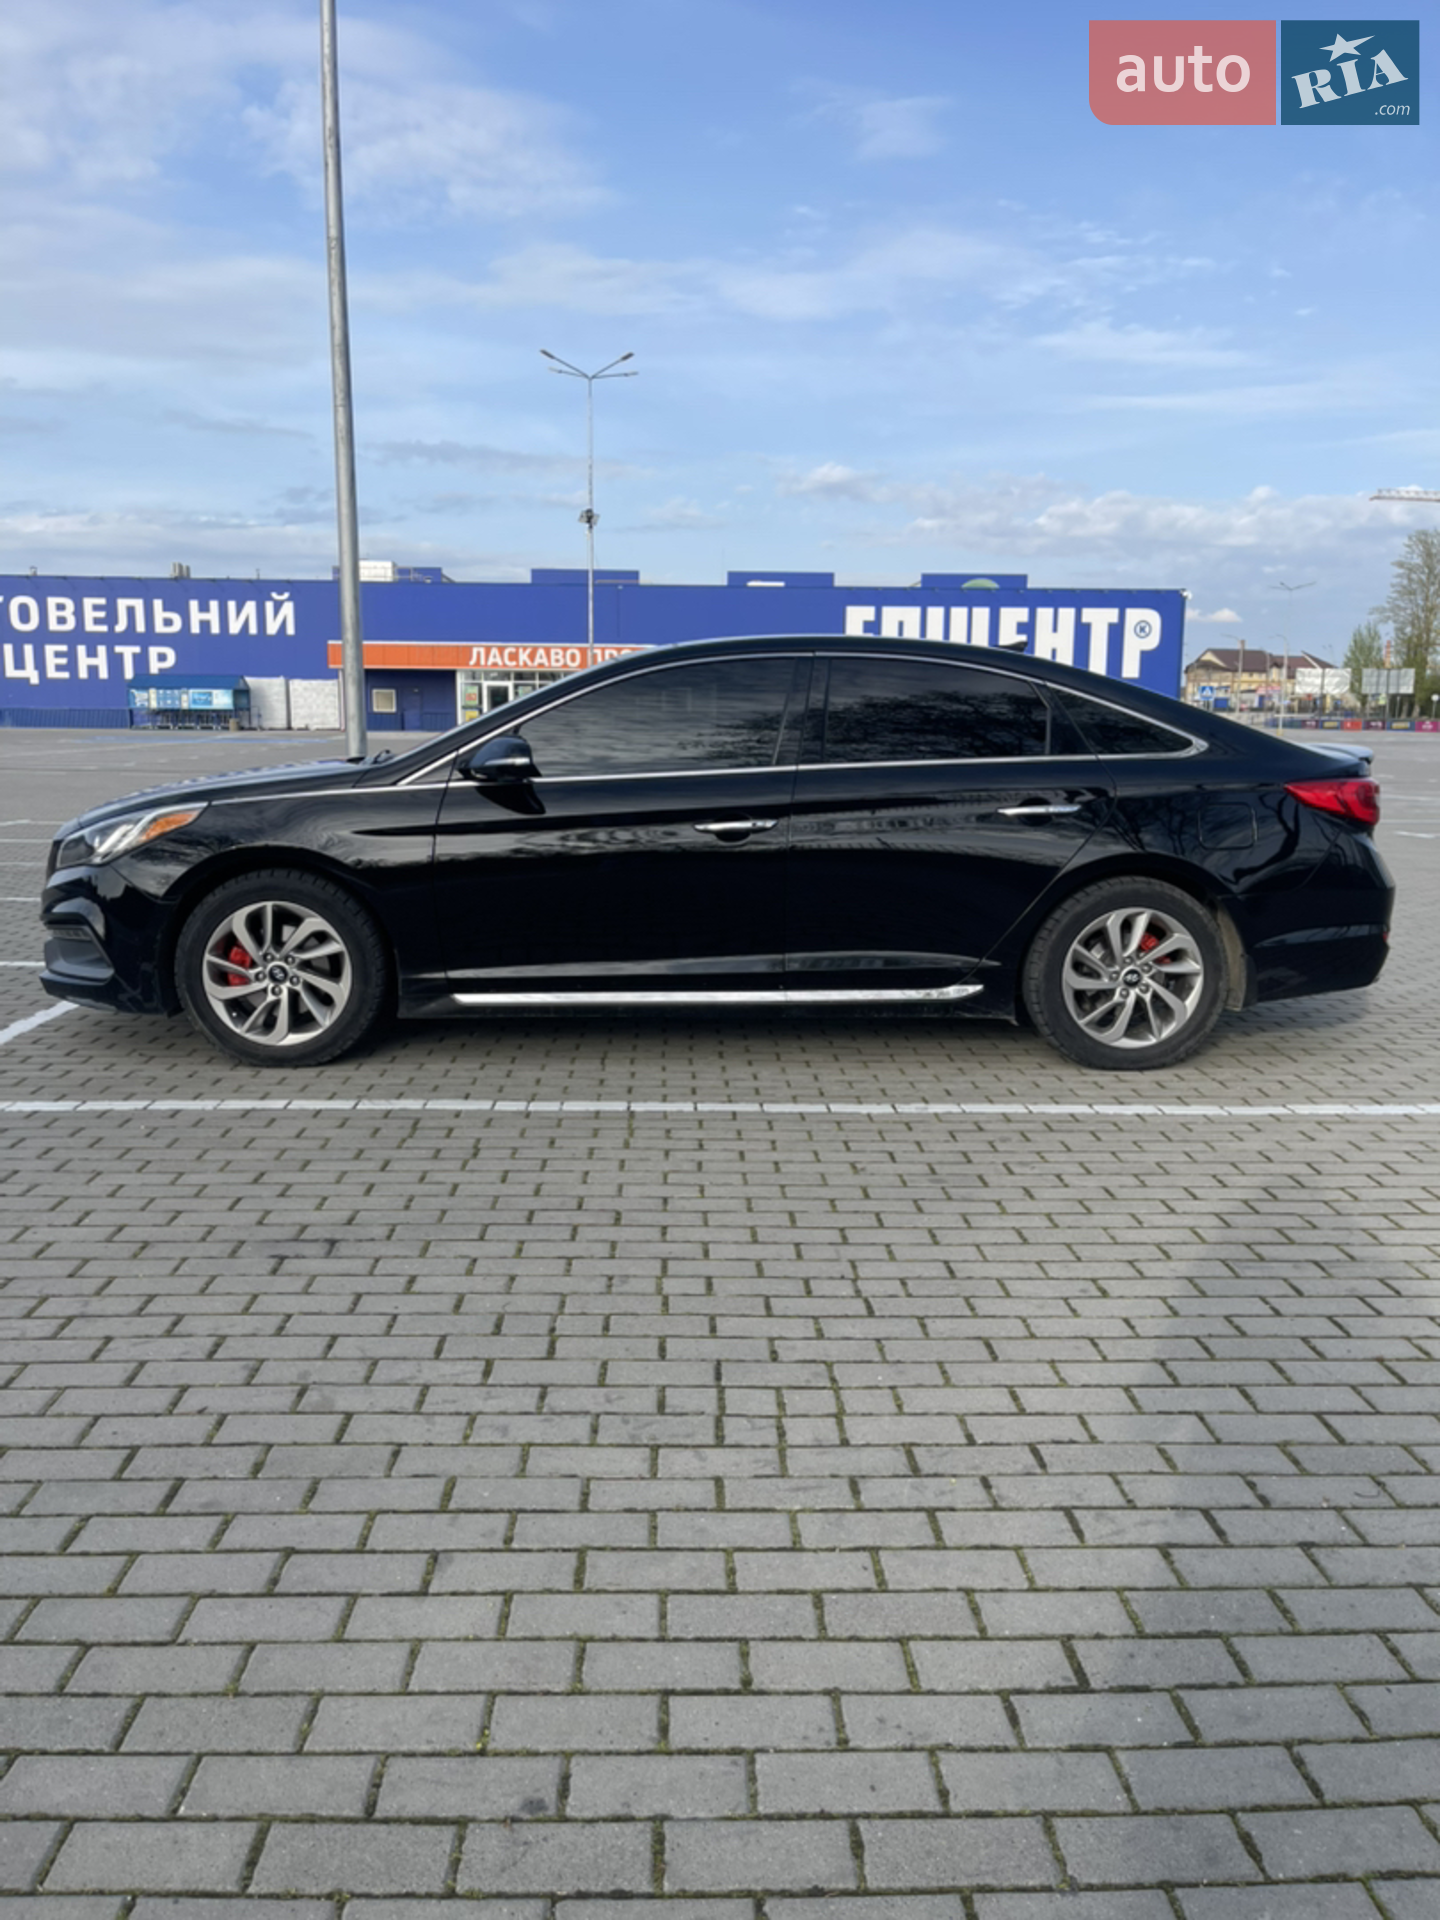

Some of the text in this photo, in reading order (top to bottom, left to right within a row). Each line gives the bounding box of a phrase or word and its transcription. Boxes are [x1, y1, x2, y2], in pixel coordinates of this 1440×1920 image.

[0, 592, 296, 636] ОВЕЛЬНИЙ
[3, 643, 177, 685] ЦЕНТР
[469, 646, 581, 668] ЛАСКАВО
